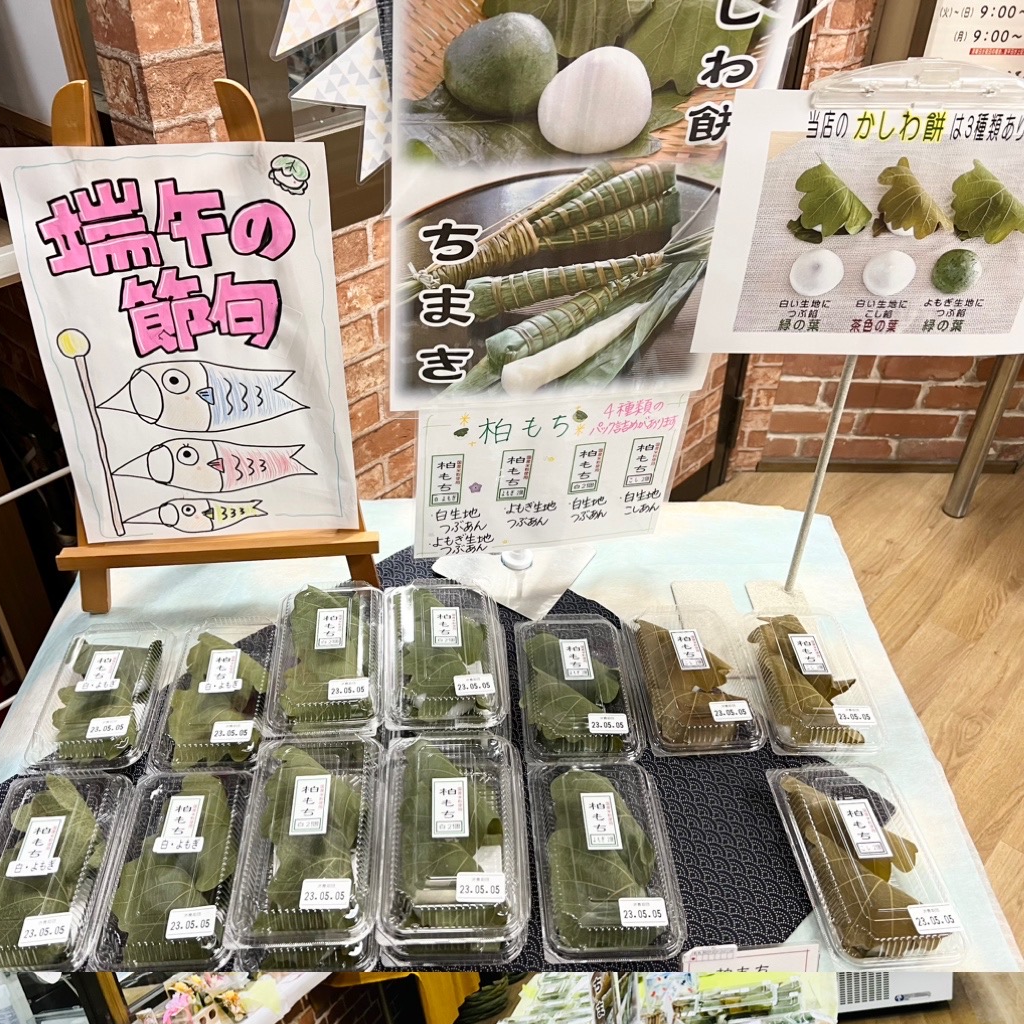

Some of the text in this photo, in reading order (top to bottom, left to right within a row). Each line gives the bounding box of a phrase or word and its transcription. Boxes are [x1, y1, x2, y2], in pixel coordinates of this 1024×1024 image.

[806, 110, 849, 139] 当店の
[853, 111, 946, 142] かしわ餅
[36, 178, 296, 276] 端午の
[420, 220, 477, 381] ちまき
[779, 300, 830, 309] 白い生地に
[856, 300, 908, 309] 白い生地に
[923, 299, 985, 308] よもぎ生地に
[118, 268, 281, 357] 節句
[778, 319, 821, 332] 緑の葉
[850, 319, 899, 333] 茶色の葉
[922, 319, 964, 332] 緑の葉
[604, 400, 664, 419] 4種類の
[479, 414, 570, 445] 柏もち
[578, 449, 597, 479] 柏もち
[634, 443, 655, 473] 柏もち
[437, 461, 456, 492] 柏もち
[505, 455, 525, 487] 柏もち
[624, 503, 659, 515] こしあん
[507, 517, 549, 528] つぶあん
[571, 510, 607, 523] つぶあん
[439, 521, 487, 533] つぶあん
[440, 544, 488, 555] つぶあん
[331, 687, 365, 695] 23.05.05
[458, 682, 491, 690] 23.05.05
[90, 724, 124, 733] 23.05.05
[214, 730, 248, 738] 23.05.05
[302, 786, 319, 816] 柏もち
[439, 788, 456, 818] 柏もち
[174, 806, 193, 836] 柏もち
[588, 802, 606, 832] 柏もち
[847, 810, 871, 840] 柏もち
[29, 827, 52, 858] 柏もち
[304, 891, 345, 900] 23.05.05
[460, 885, 501, 894] 23.05.05
[624, 910, 662, 918] 23.05.05
[918, 915, 955, 926] 23.05.05
[171, 919, 210, 930] 23.05.05
[24, 926, 65, 938] 23.05.05
